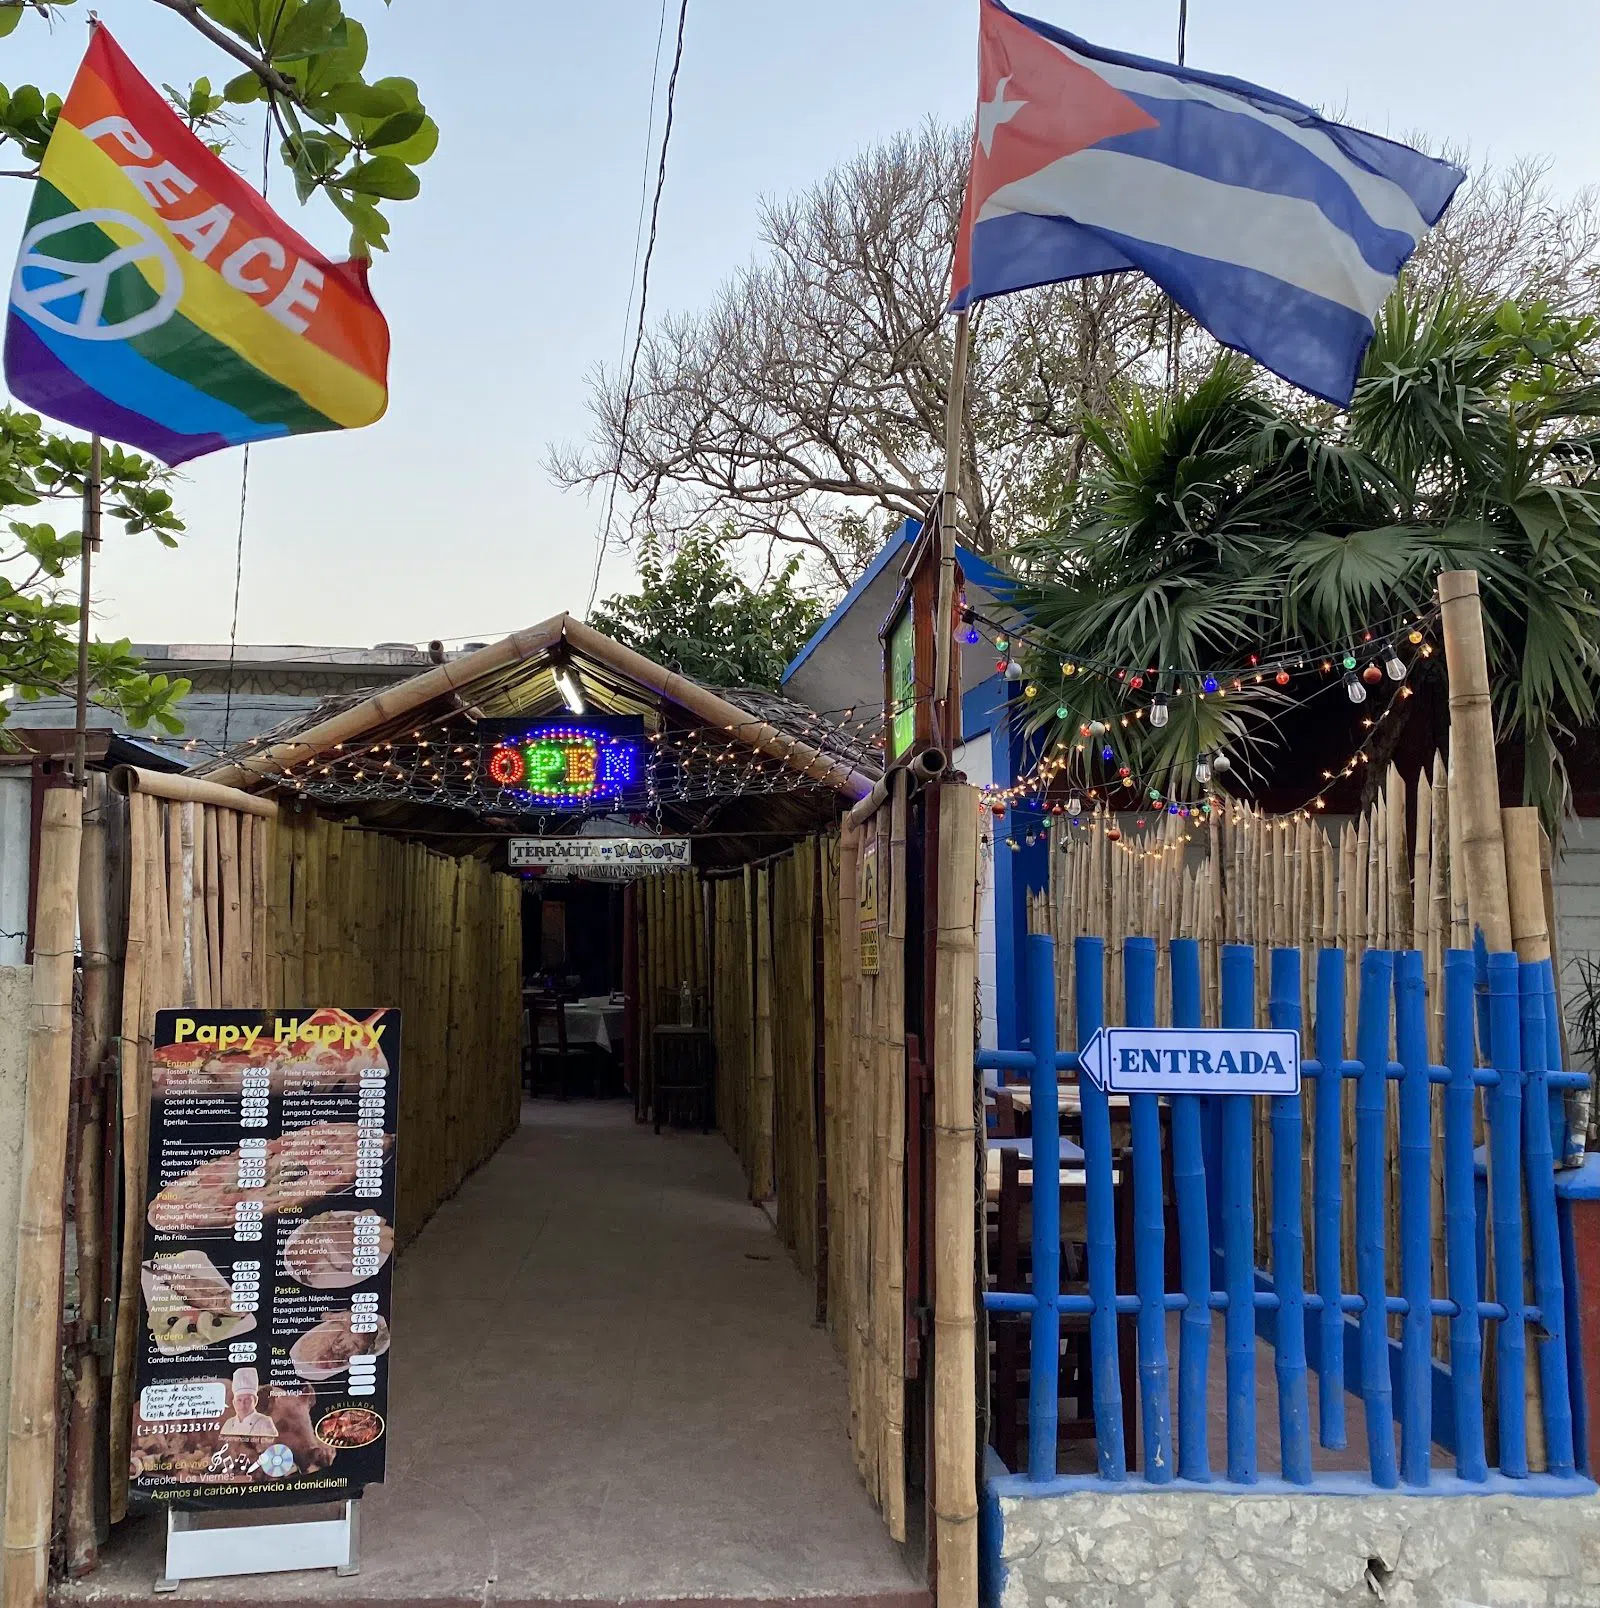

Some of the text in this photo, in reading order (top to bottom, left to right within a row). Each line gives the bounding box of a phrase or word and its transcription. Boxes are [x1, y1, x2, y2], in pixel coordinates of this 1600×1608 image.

[81, 115, 325, 334] PEACE
[490, 746, 634, 784] OPEN
[514, 845, 600, 857] TERRACITA
[174, 1017, 387, 1051] Papy Happy
[1119, 1048, 1287, 1074] ENTRADA
[362, 1069, 383, 1078] 895
[301, 1079, 320, 1088] Aguja
[165, 1088, 198, 1096] Croquetas
[283, 1089, 311, 1097] Canciller
[361, 1089, 385, 1098] 1020
[195, 1098, 225, 1106] Langosta
[336, 1099, 353, 1107] Ajillo
[195, 1107, 231, 1115] Camarones
[282, 1109, 311, 1118] Langosta
[281, 1119, 311, 1128] Langosta
[281, 1129, 310, 1138] Langosta
[242, 1138, 265, 1148] 250
[280, 1139, 310, 1148] Langosta
[209, 1148, 230, 1156] Queso
[242, 1159, 264, 1168] 550
[160, 1170, 181, 1178] Papas
[242, 1169, 264, 1177] 300
[279, 1168, 343, 1177] Camarón Empanado
[156, 1203, 185, 1212] Pechuga
[277, 1206, 304, 1215] Cerdo
[155, 1213, 184, 1222] Pechuga
[238, 1213, 261, 1221] 1125
[238, 1222, 261, 1231] 1150
[239, 1232, 257, 1242] 950
[314, 1237, 334, 1245] Cerdo
[356, 1236, 375, 1245] 800
[308, 1248, 328, 1256] Cerdo
[234, 1272, 257, 1281] 1150
[274, 1286, 301, 1295] Pastas
[273, 1294, 334, 1305] Espaguetis Nápoles
[272, 1305, 330, 1315] Espaguetis Jamón
[289, 1316, 316, 1324] Nápoles
[272, 1327, 299, 1336] Lasagna
[271, 1347, 287, 1356] Res
[147, 1355, 204, 1364] Cordero Estofado
[151, 1377, 188, 1386] Sugerencia
[201, 1374, 218, 1382] Chef
[269, 1378, 301, 1386] Riñonada
[171, 1385, 179, 1393] de
[181, 1384, 205, 1392] Queso
[286, 1389, 304, 1398] Vieja
[167, 1407, 223, 1417] de Happy
[136, 1422, 221, 1437] (+53)53233176
[189, 1459, 209, 1469] vivo
[137, 1472, 235, 1486] Kareoke Los Viernes
[150, 1477, 348, 1500] Azamos al carbón y servicio a domicilio!!!!
